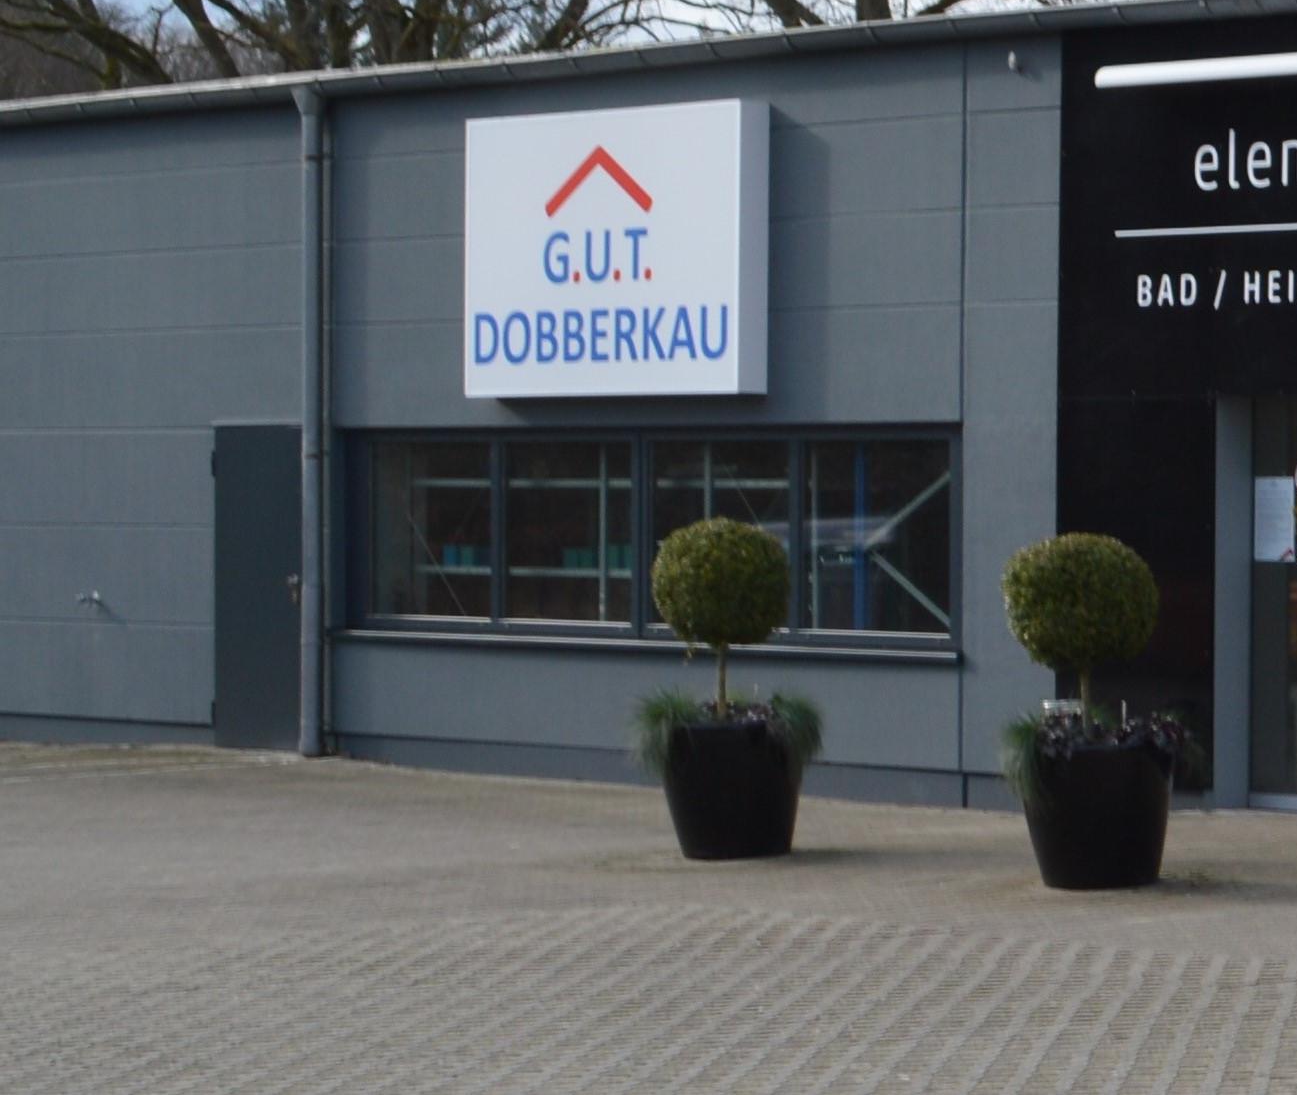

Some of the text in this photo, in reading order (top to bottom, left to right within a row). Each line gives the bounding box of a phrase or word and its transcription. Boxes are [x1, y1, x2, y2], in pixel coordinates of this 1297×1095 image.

[542, 226, 653, 285] G.U.T.
[1136, 272, 1198, 308] BAD
[473, 304, 729, 366] DOBBERKAU
